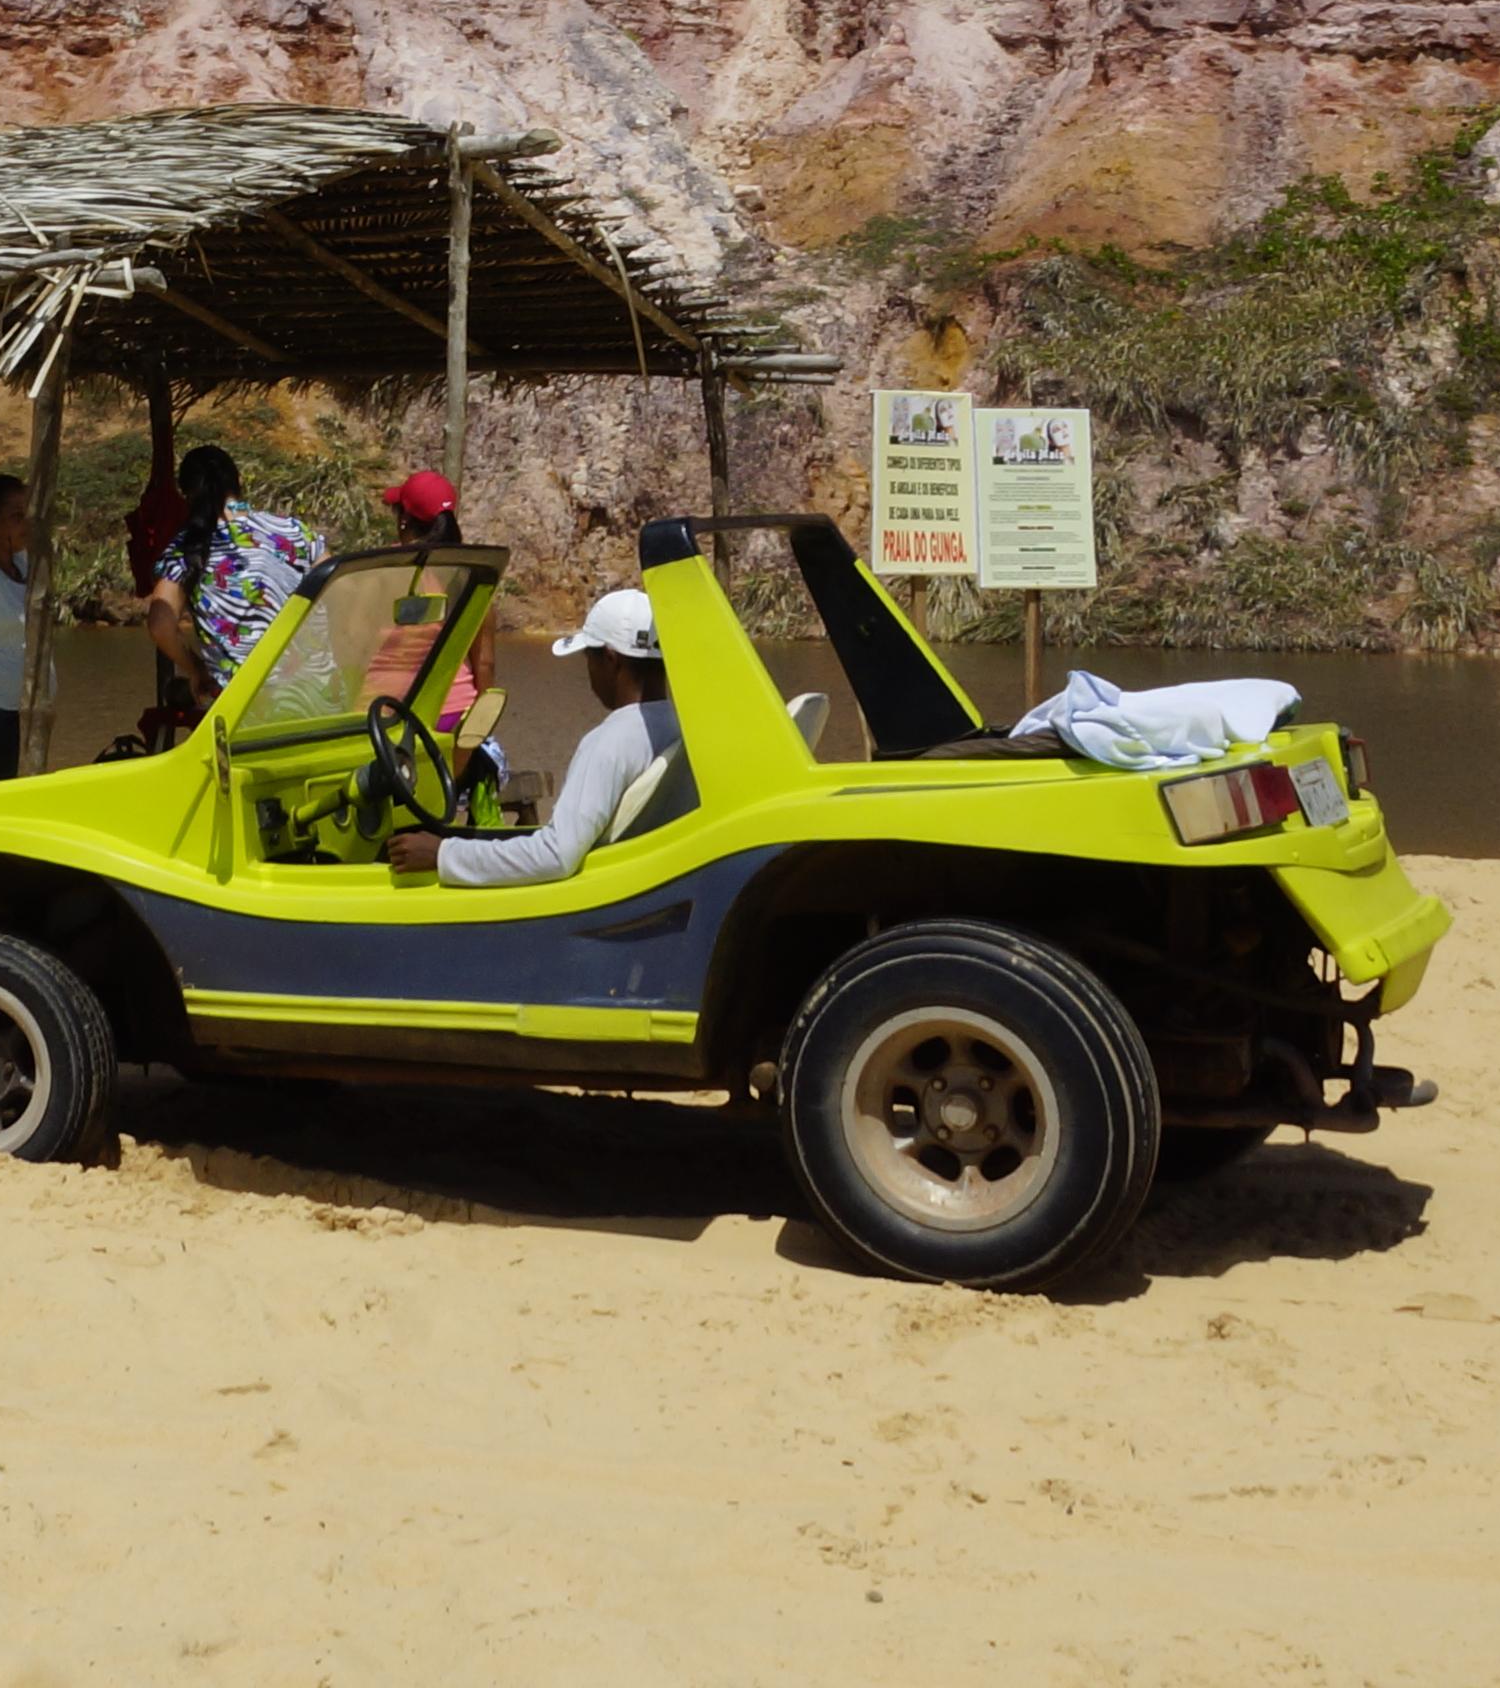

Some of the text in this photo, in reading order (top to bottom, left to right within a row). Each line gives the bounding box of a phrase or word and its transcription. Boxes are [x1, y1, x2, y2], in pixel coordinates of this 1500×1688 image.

[883, 530, 911, 562] PRAIA
[914, 531, 927, 562] DO
[930, 531, 967, 563] GUNGA.
